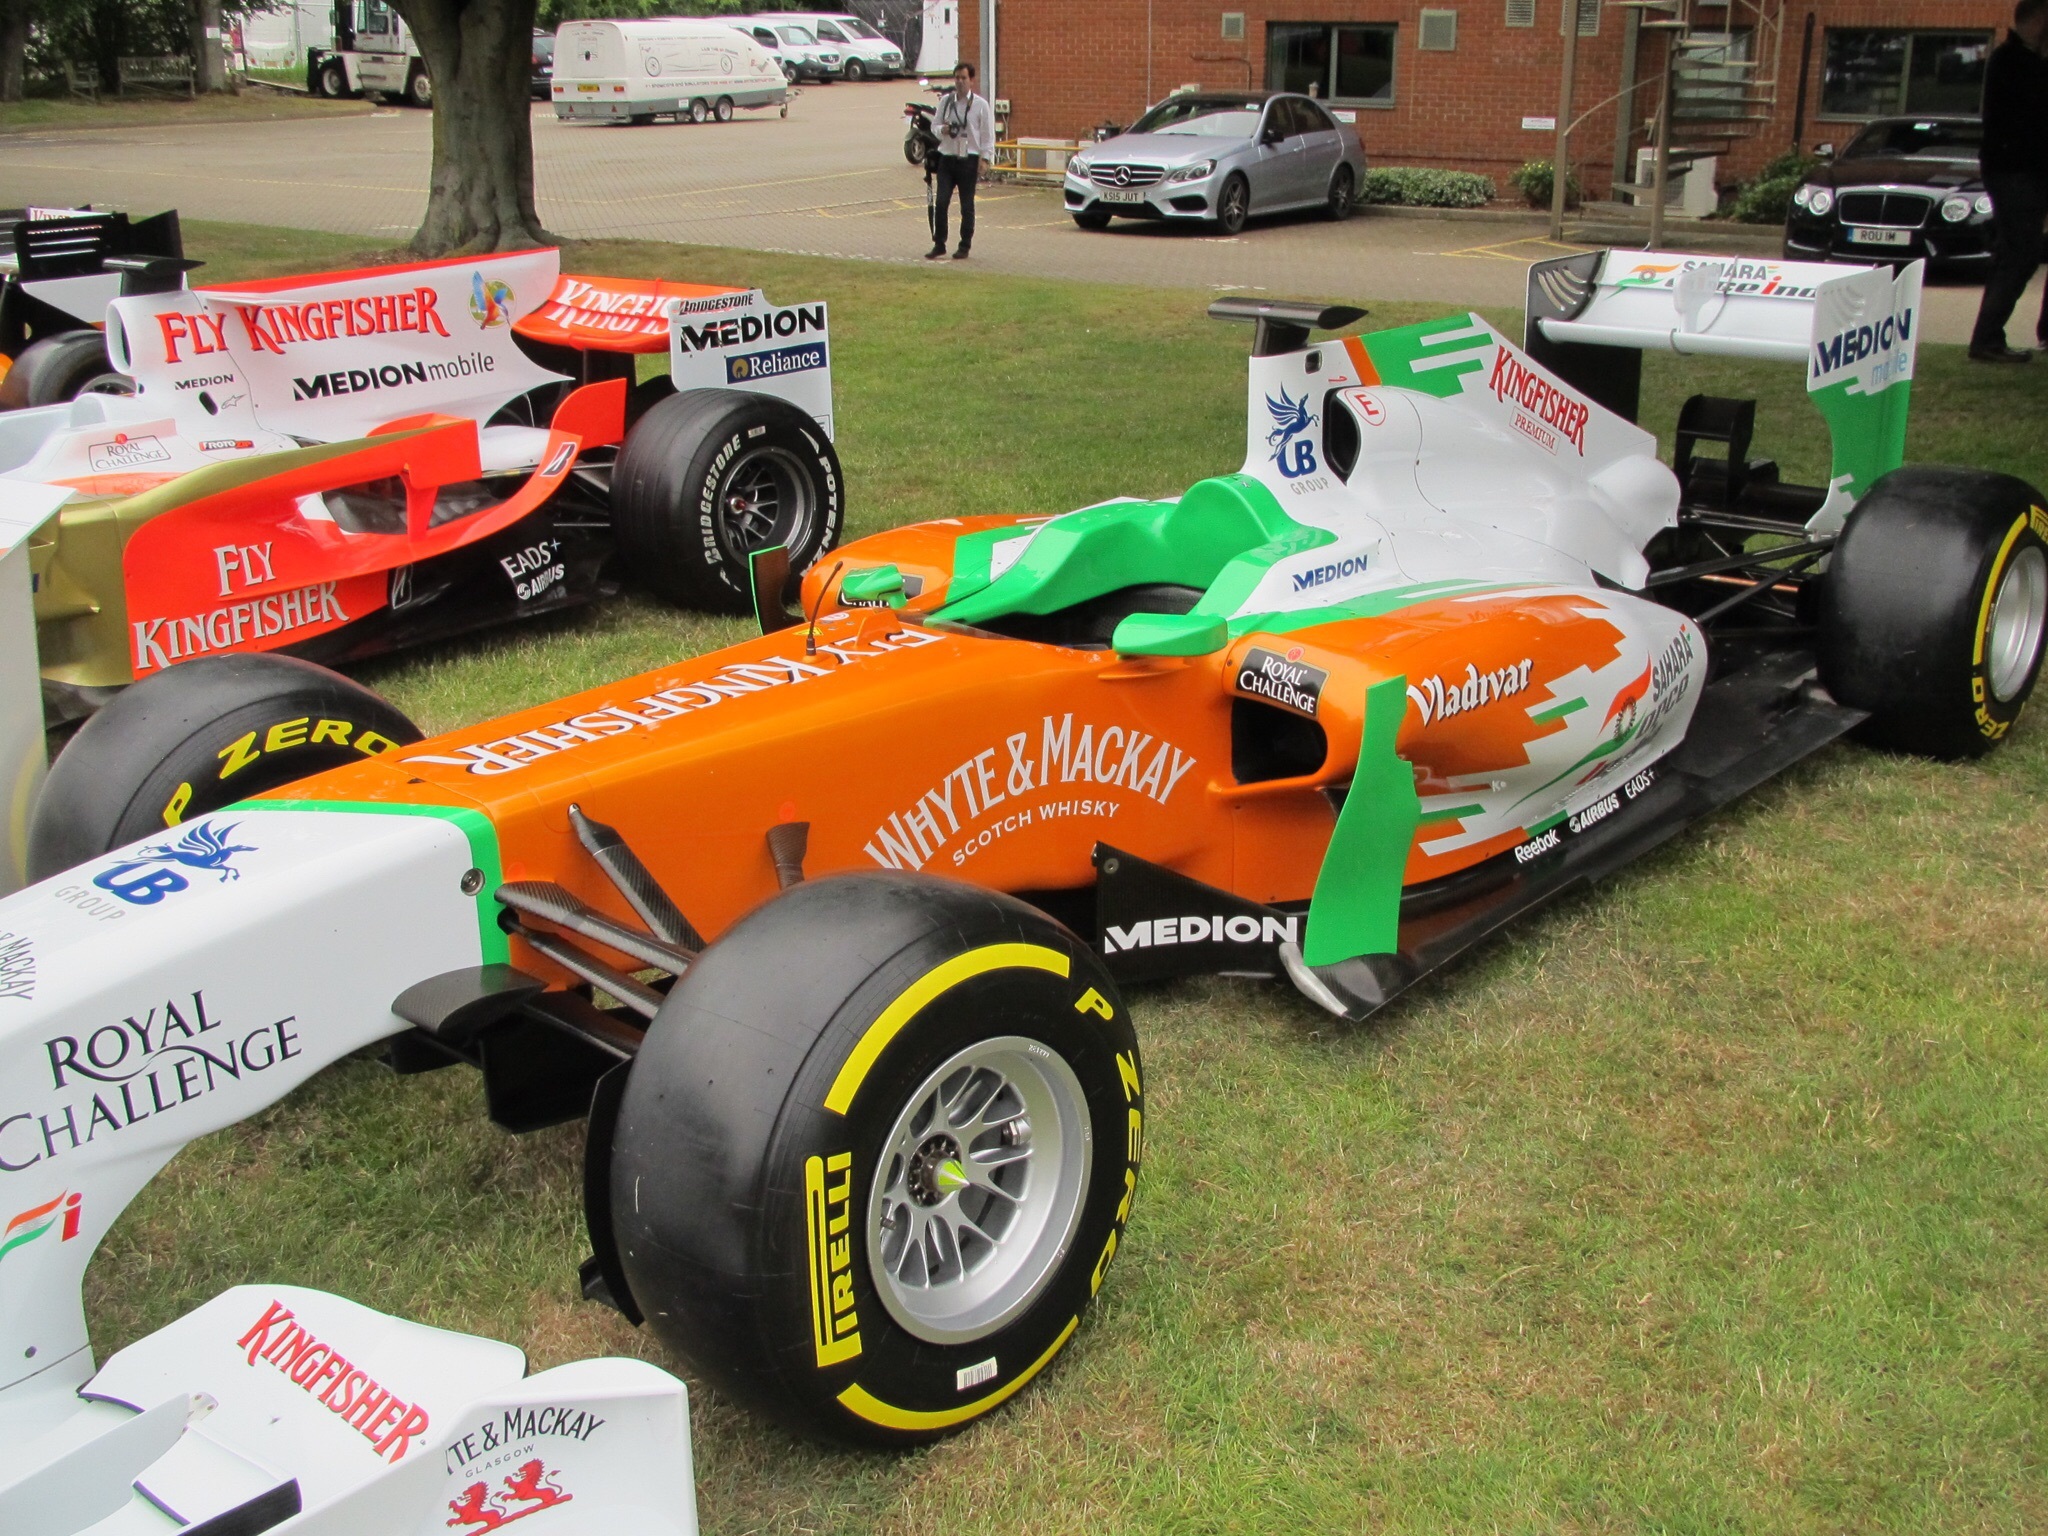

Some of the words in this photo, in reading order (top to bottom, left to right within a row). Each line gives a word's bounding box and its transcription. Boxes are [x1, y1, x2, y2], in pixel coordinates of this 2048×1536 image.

[155, 311, 228, 364] FLY
[235, 286, 451, 355] KINGFISHER
[679, 294, 753, 315] BRIDGESTONE
[680, 305, 825, 353] MEDION
[174, 373, 235, 391] MEDION
[749, 350, 820, 377] Reliance
[1488, 344, 1590, 458] KINGFISHER
[1513, 413, 1556, 450] PREMIUM
[700, 433, 742, 565] BRIDGESTONE
[1290, 477, 1329, 495] GROUP
[212, 541, 277, 597] FLY
[1292, 554, 1368, 593] MEDION
[132, 580, 350, 669] KINGFISHER
[1240, 670, 1316, 714] CHALLENGE
[1261, 655, 1304, 686] ROYAL
[1407, 658, 1534, 726] Vladivar
[1652, 630, 1694, 703] SAHARA
[402, 655, 835, 777] KINGFISHER
[218, 717, 401, 779] ZERO
[862, 747, 1006, 871] WHYTE
[1005, 732, 1035, 797] &
[1039, 712, 1197, 805] MACKAY
[1580, 792, 1620, 829] AIRBUS
[952, 809, 1033, 867] SCOTCH
[1038, 799, 1120, 821] WHISKY
[1514, 828, 1561, 864] Reebok
[54, 885, 125, 921] GROUP
[1104, 915, 1297, 954] MEDION
[1074, 986, 1114, 1021] P
[43, 989, 222, 1091] ROYAL
[0, 1015, 302, 1172] CHALLENGE
[1091, 1049, 1141, 1299] ZERO
[805, 1151, 864, 1368] PIRELLI
[237, 1299, 430, 1466] KINGFISHER
[481, 1421, 501, 1451] &
[503, 1406, 607, 1443] MACKAY
[465, 1443, 535, 1478] GLASGOW
